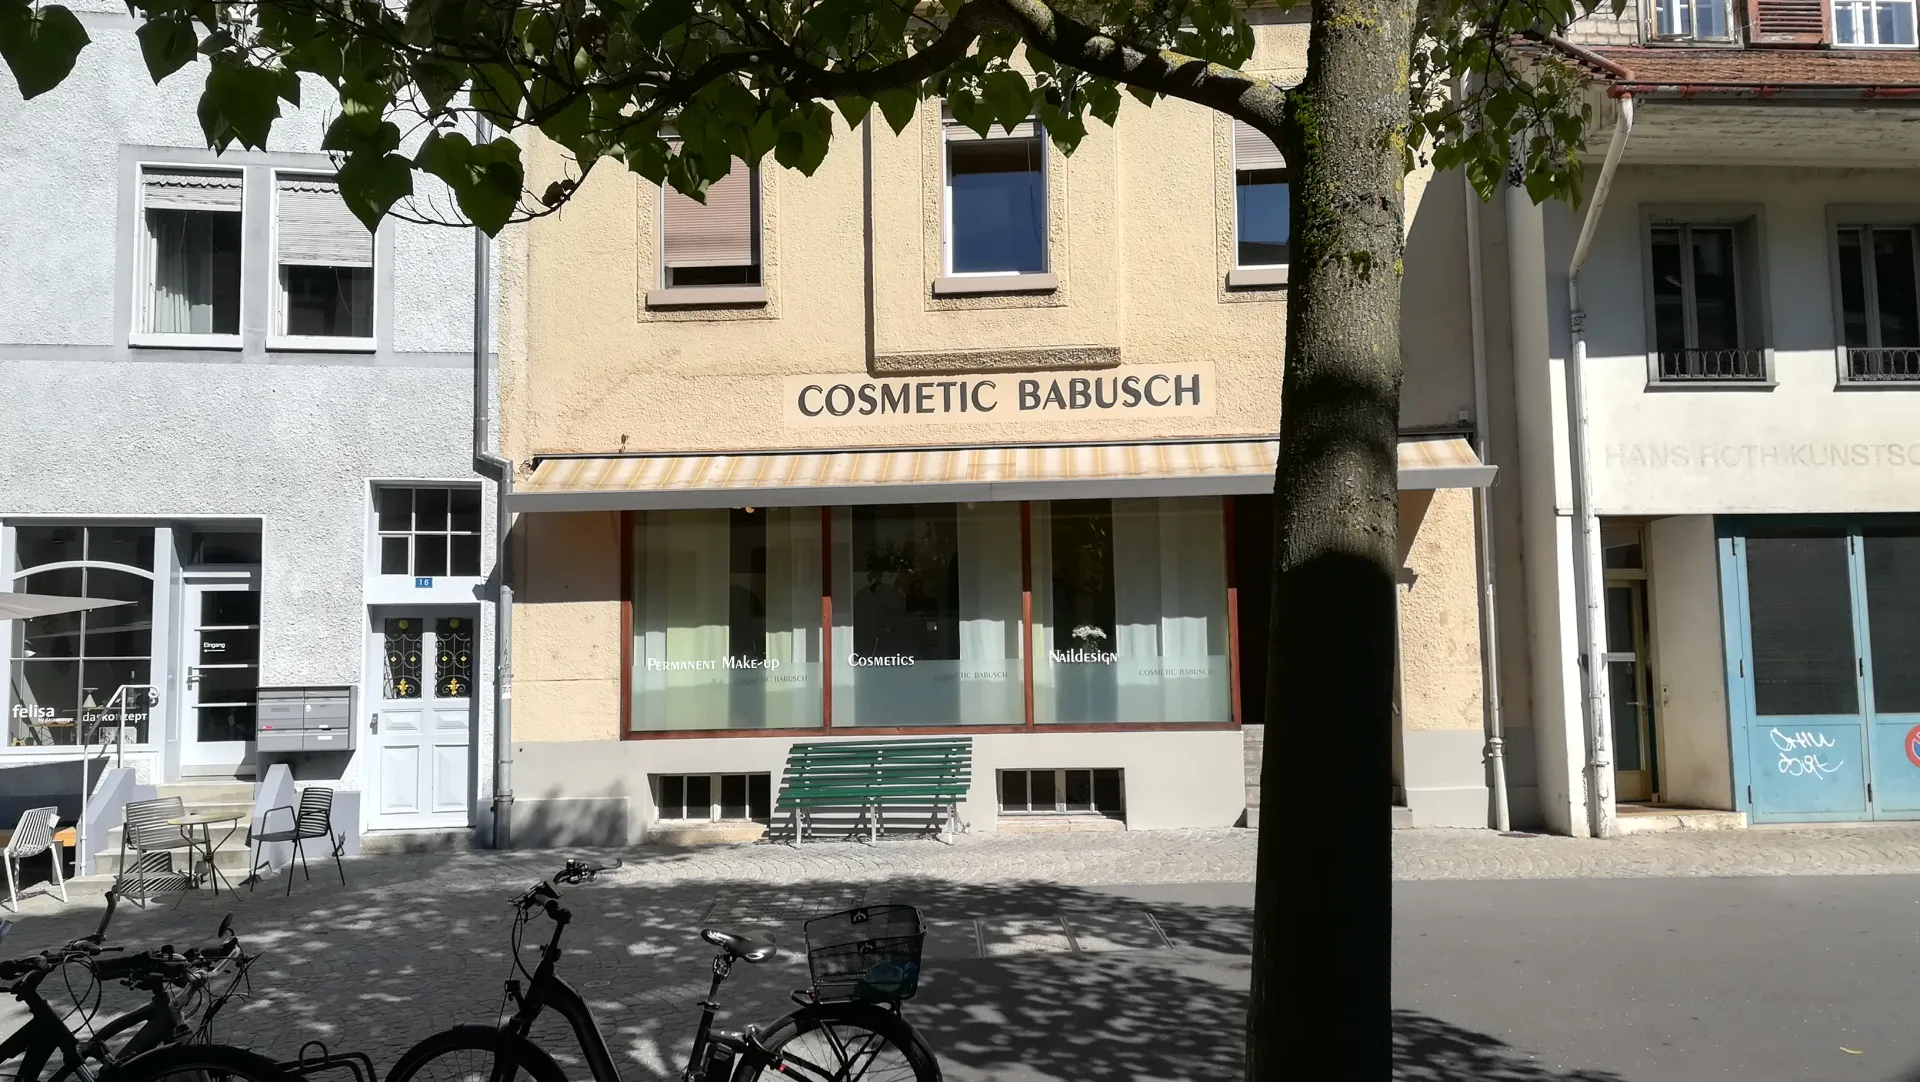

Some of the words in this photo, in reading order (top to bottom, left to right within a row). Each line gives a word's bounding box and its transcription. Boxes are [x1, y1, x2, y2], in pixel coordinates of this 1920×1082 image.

[797, 379, 998, 417] COSMETIC
[1018, 373, 1201, 411] BABUSCH
[1604, 443, 1691, 468] HANS
[419, 578, 430, 586] 16
[203, 641, 226, 649] Eingang
[974, 671, 1008, 679] BABUSCH
[1138, 668, 1176, 676] COSMETIC
[1179, 667, 1214, 676] BABUSCH
[774, 674, 808, 683] BABUSCH
[12, 703, 55, 718] felisa
[82, 711, 148, 724] daskozept
